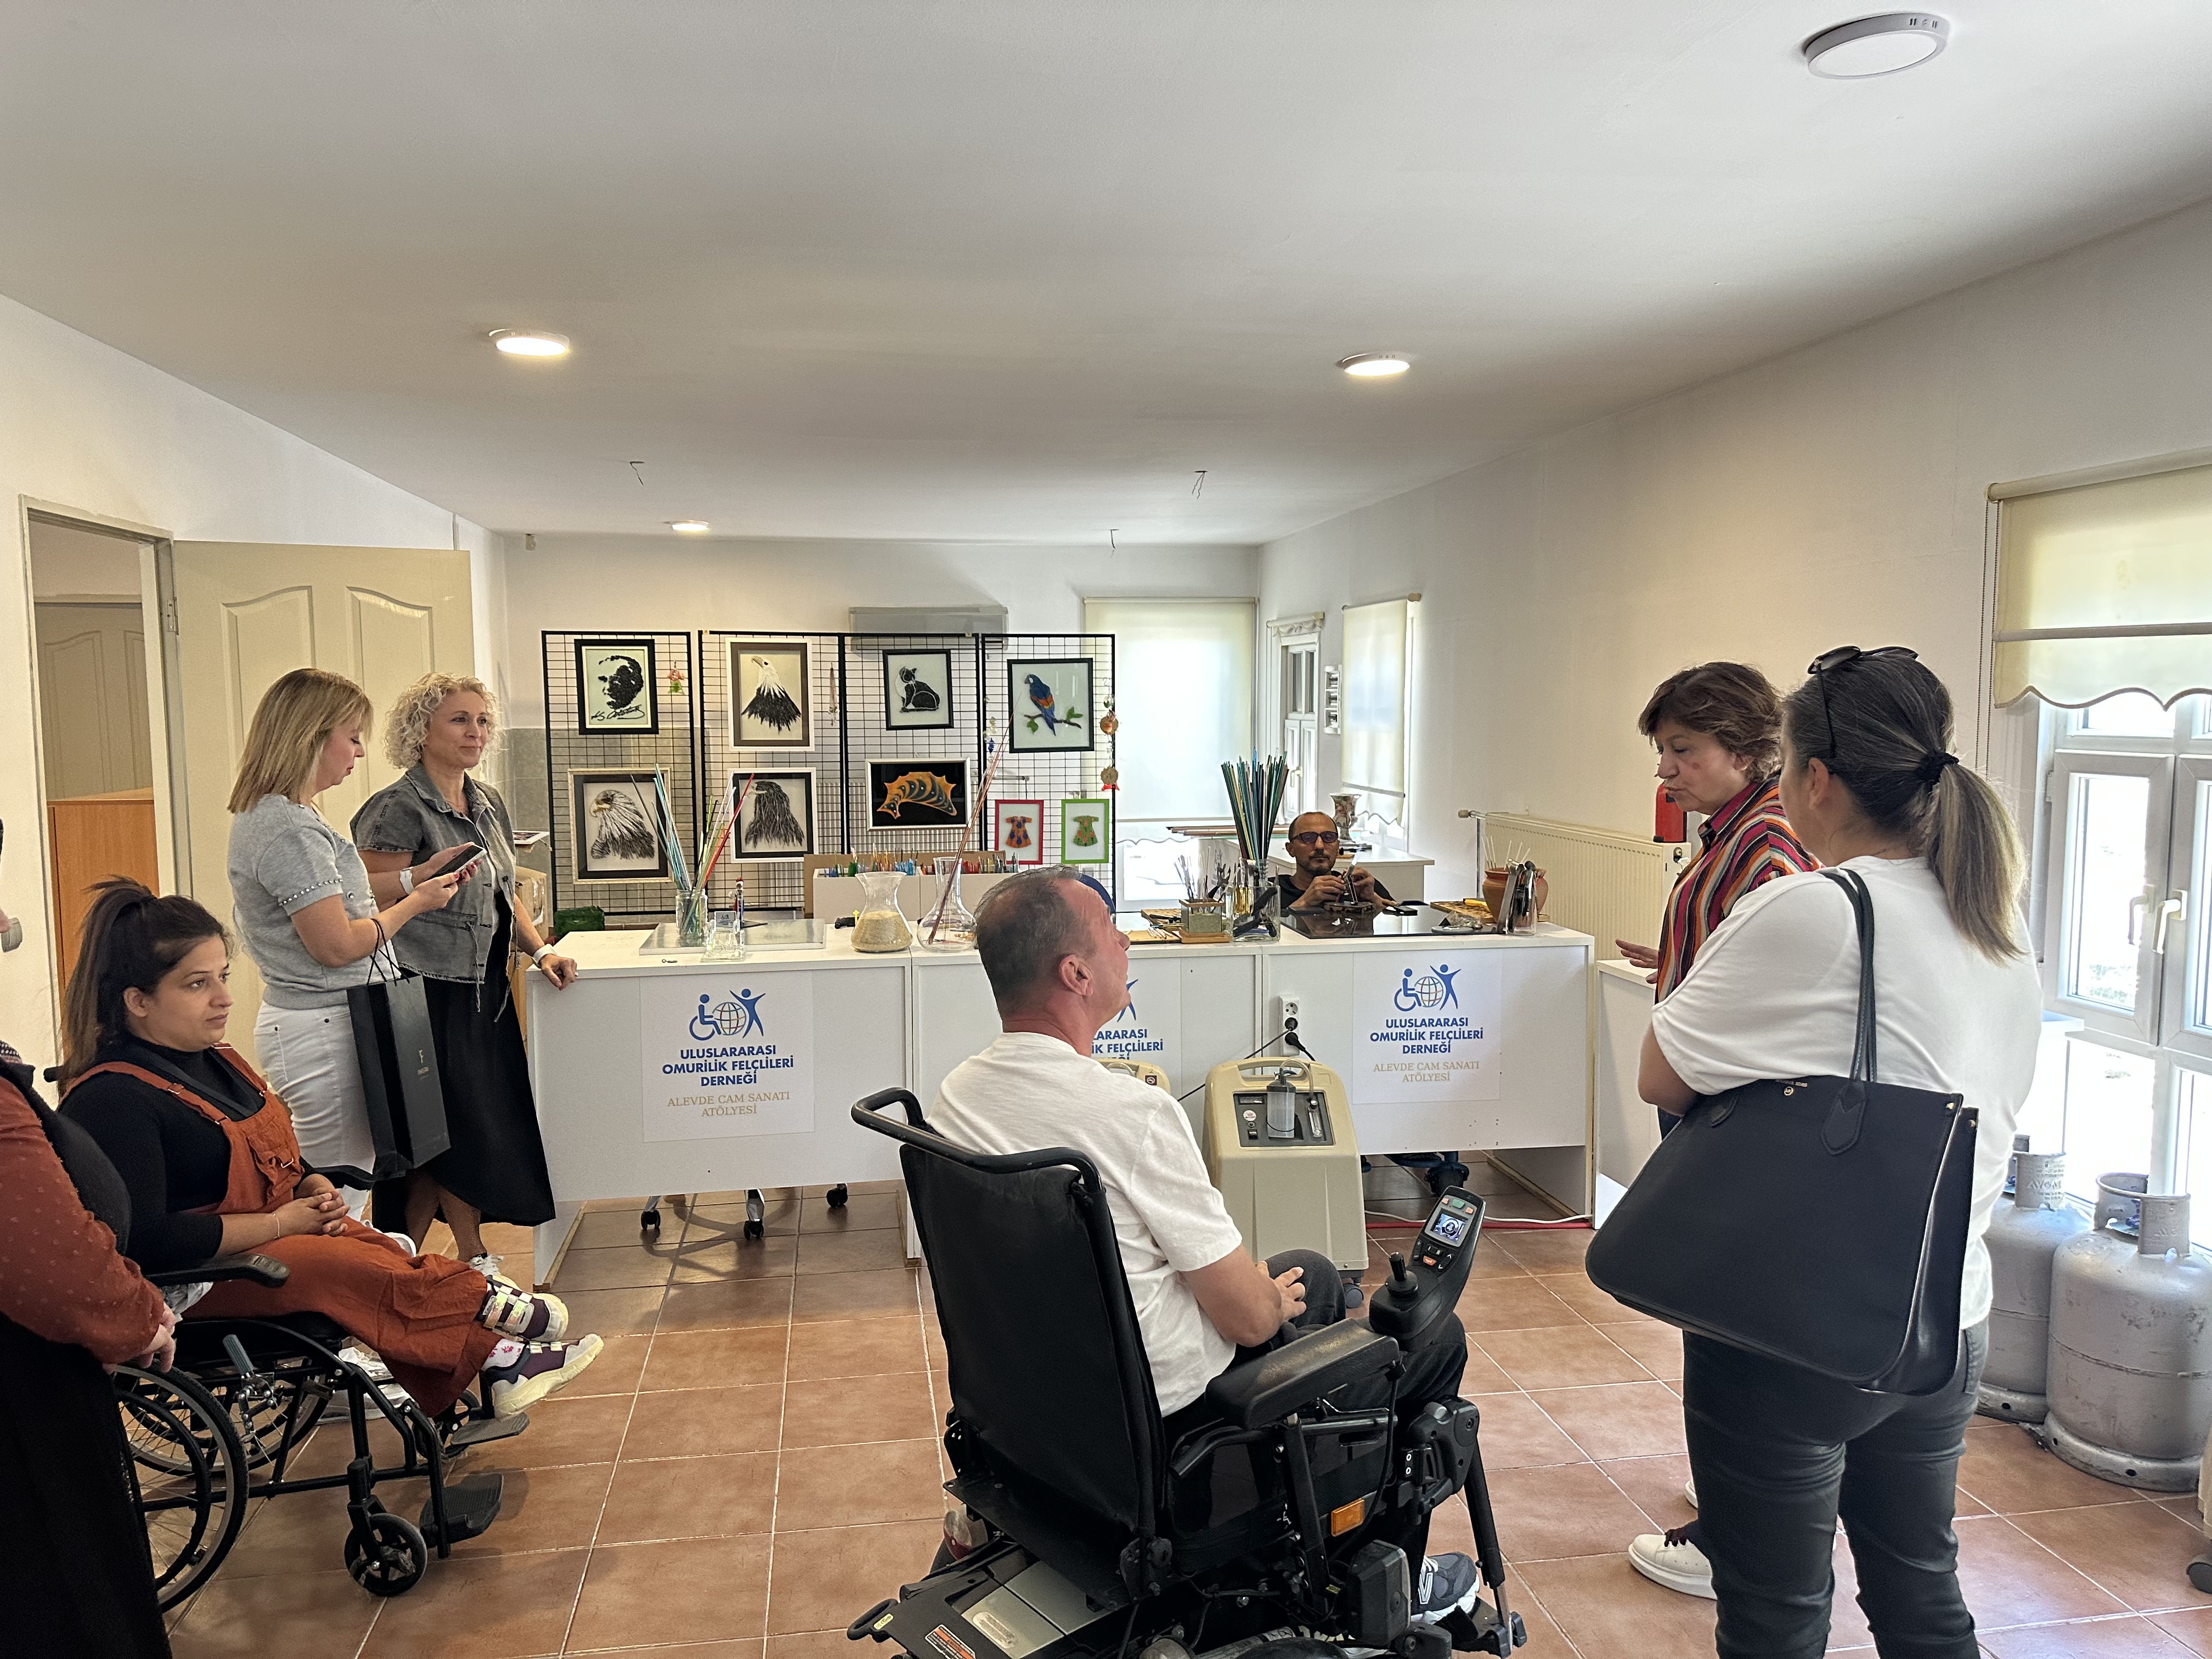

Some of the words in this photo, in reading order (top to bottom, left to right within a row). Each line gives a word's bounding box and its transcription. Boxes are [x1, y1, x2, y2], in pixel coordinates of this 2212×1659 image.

[1385, 1017, 1469, 1028] ULUSLARARASI
[1093, 1029, 1148, 1040] ARARASI
[1369, 1029, 1426, 1042] OMURİLİK
[1429, 1027, 1483, 1041] FELÇLİLERİ
[680, 1045, 776, 1059] ULUSLARARASI
[1107, 1038, 1164, 1054] FELÇLİLERİ
[1402, 1041, 1451, 1054] DERNEĞİ
[662, 1057, 727, 1074] OMURİLİK
[731, 1055, 794, 1073] FELÇLİLERİ
[1373, 1063, 1414, 1072] ALEVDE
[1417, 1062, 1440, 1070] CAM
[1442, 1061, 1480, 1070] SANATI
[701, 1070, 757, 1087] DERNEĞİ
[1402, 1070, 1451, 1082] ATÖLYESİ
[667, 1095, 714, 1107] ALEVDE
[718, 1093, 744, 1104] CAM
[748, 1091, 790, 1102] SANATI
[701, 1103, 758, 1117] ATÖLYESİ
